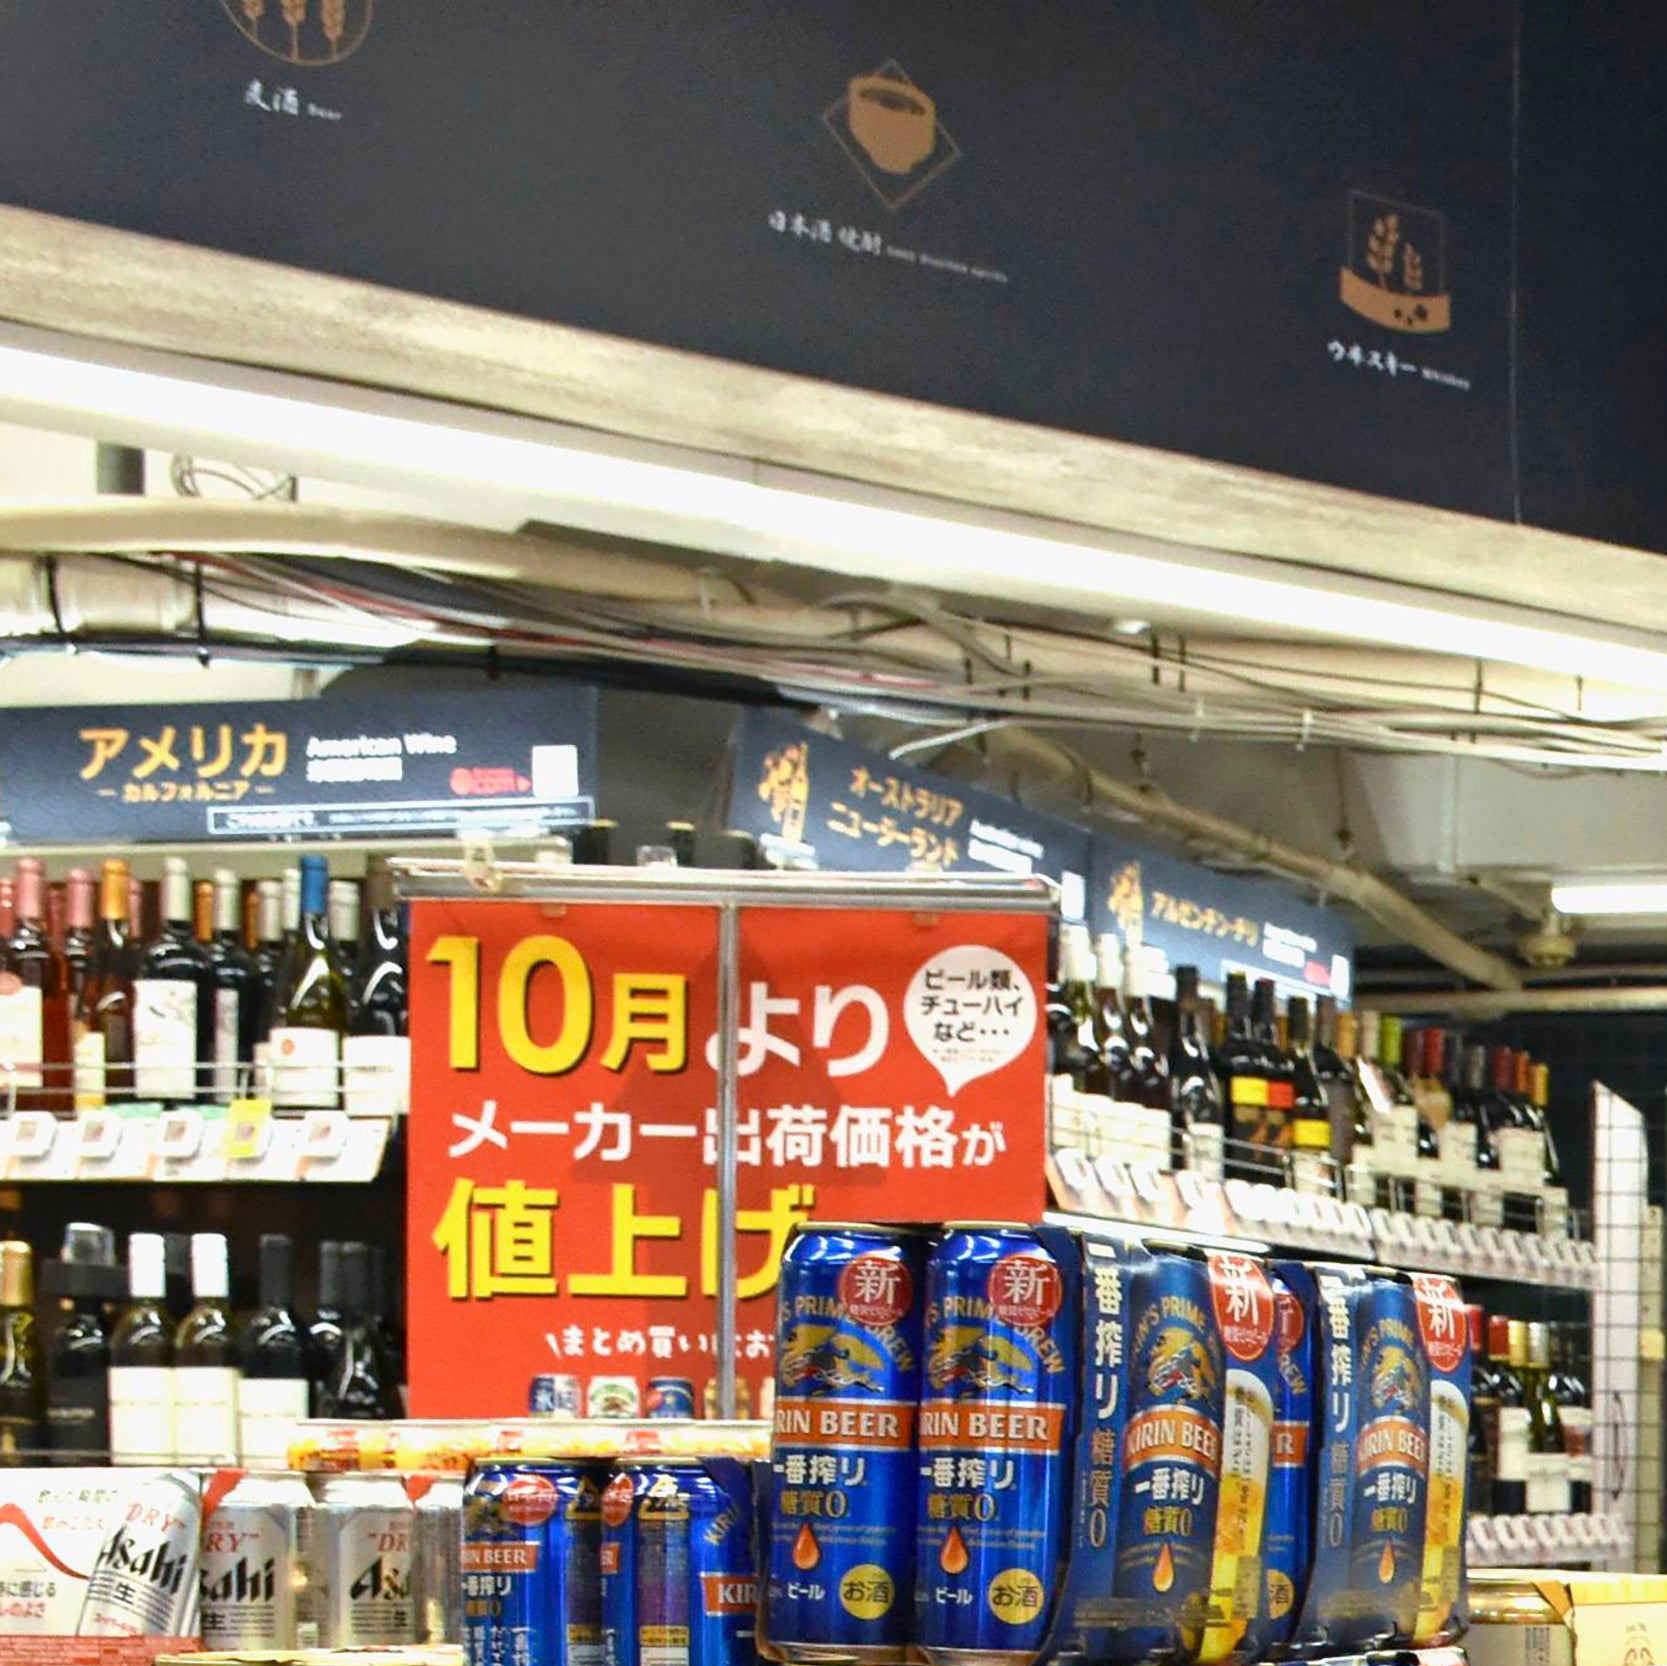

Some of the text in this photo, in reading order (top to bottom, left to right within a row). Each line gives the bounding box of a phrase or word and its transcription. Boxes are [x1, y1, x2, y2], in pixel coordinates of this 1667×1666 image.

[78, 724, 288, 780] アメリカ
[925, 968, 1021, 992] ビール類、
[426, 935, 889, 1077] 10月より
[920, 994, 1021, 1018] チューハイ
[449, 1101, 1004, 1167] メーカー出荷価格が
[854, 1260, 901, 1304] 新
[1002, 1259, 1052, 1306] 新
[773, 1456, 866, 1487] 一番搾り
[920, 1457, 1016, 1490] 一番搾り
[1134, 1467, 1204, 1505] 一番搾り
[101, 1525, 188, 1598] Asahi
[787, 1584, 825, 1600] ビール
[843, 1580, 891, 1605] お酒
[935, 1586, 973, 1605] ビール
[991, 1584, 1041, 1608] お酒
